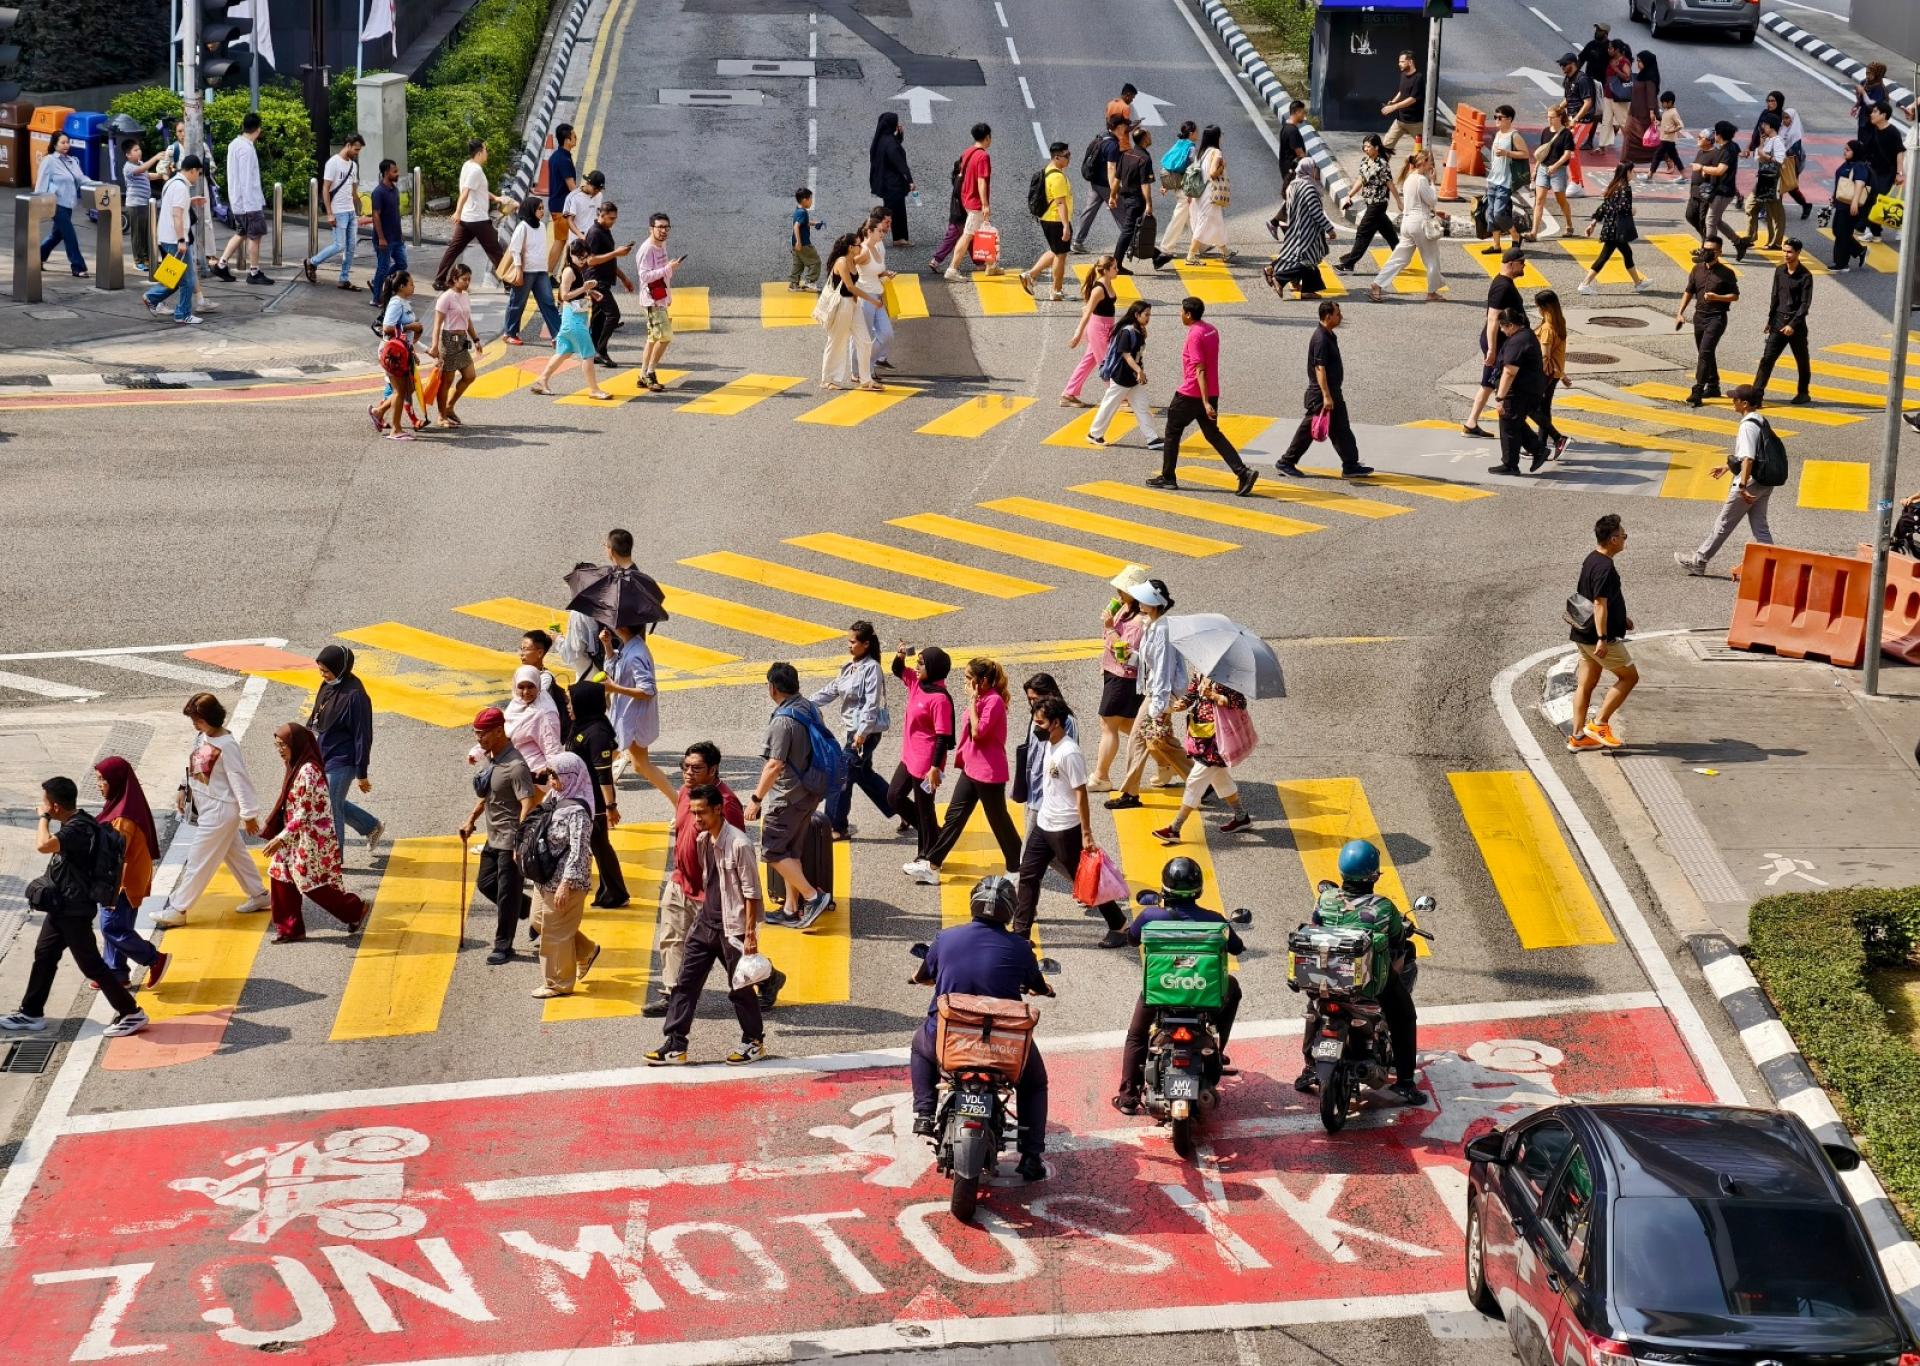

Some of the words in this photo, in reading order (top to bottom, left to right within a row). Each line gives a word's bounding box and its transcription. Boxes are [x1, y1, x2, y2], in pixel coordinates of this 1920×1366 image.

[1160, 971, 1207, 990] Grab
[1173, 1080, 1190, 1089] AMV
[965, 1094, 985, 1104] VDL
[960, 1103, 986, 1114] 3760
[32, 1237, 500, 1362] ZON
